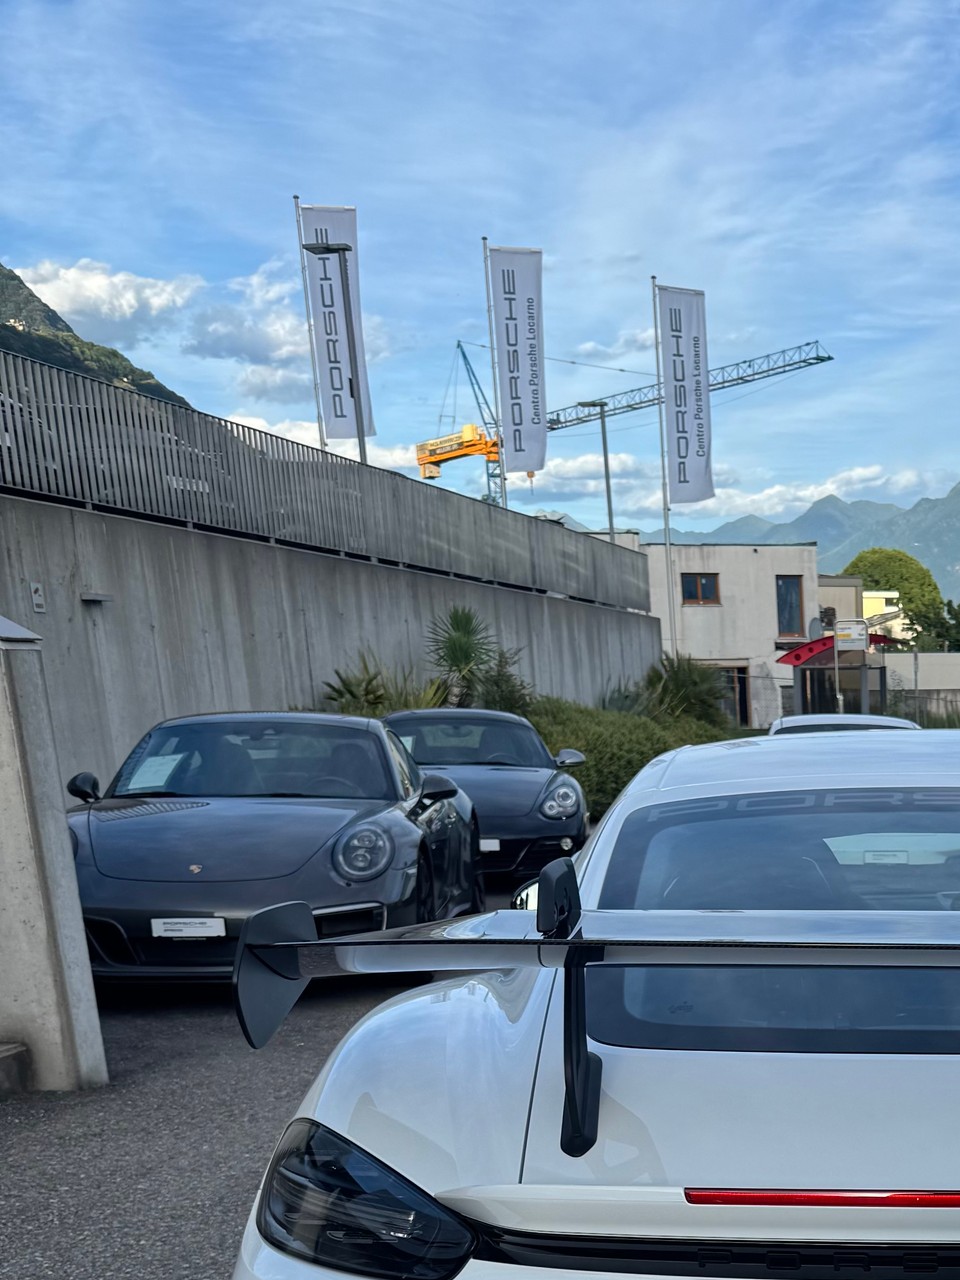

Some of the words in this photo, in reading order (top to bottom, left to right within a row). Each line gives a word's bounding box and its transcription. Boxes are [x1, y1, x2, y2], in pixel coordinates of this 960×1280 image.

[314, 227, 347, 419] PORSCHE
[526, 296, 535, 341] Locarno
[501, 268, 526, 453] PORSCHE
[526, 342, 540, 387] Porsche
[692, 335, 702, 377] Locarno
[530, 387, 542, 426] Centro
[669, 307, 690, 484] PORSCHE
[692, 378, 705, 421] Porsche
[695, 421, 706, 458] Centro
